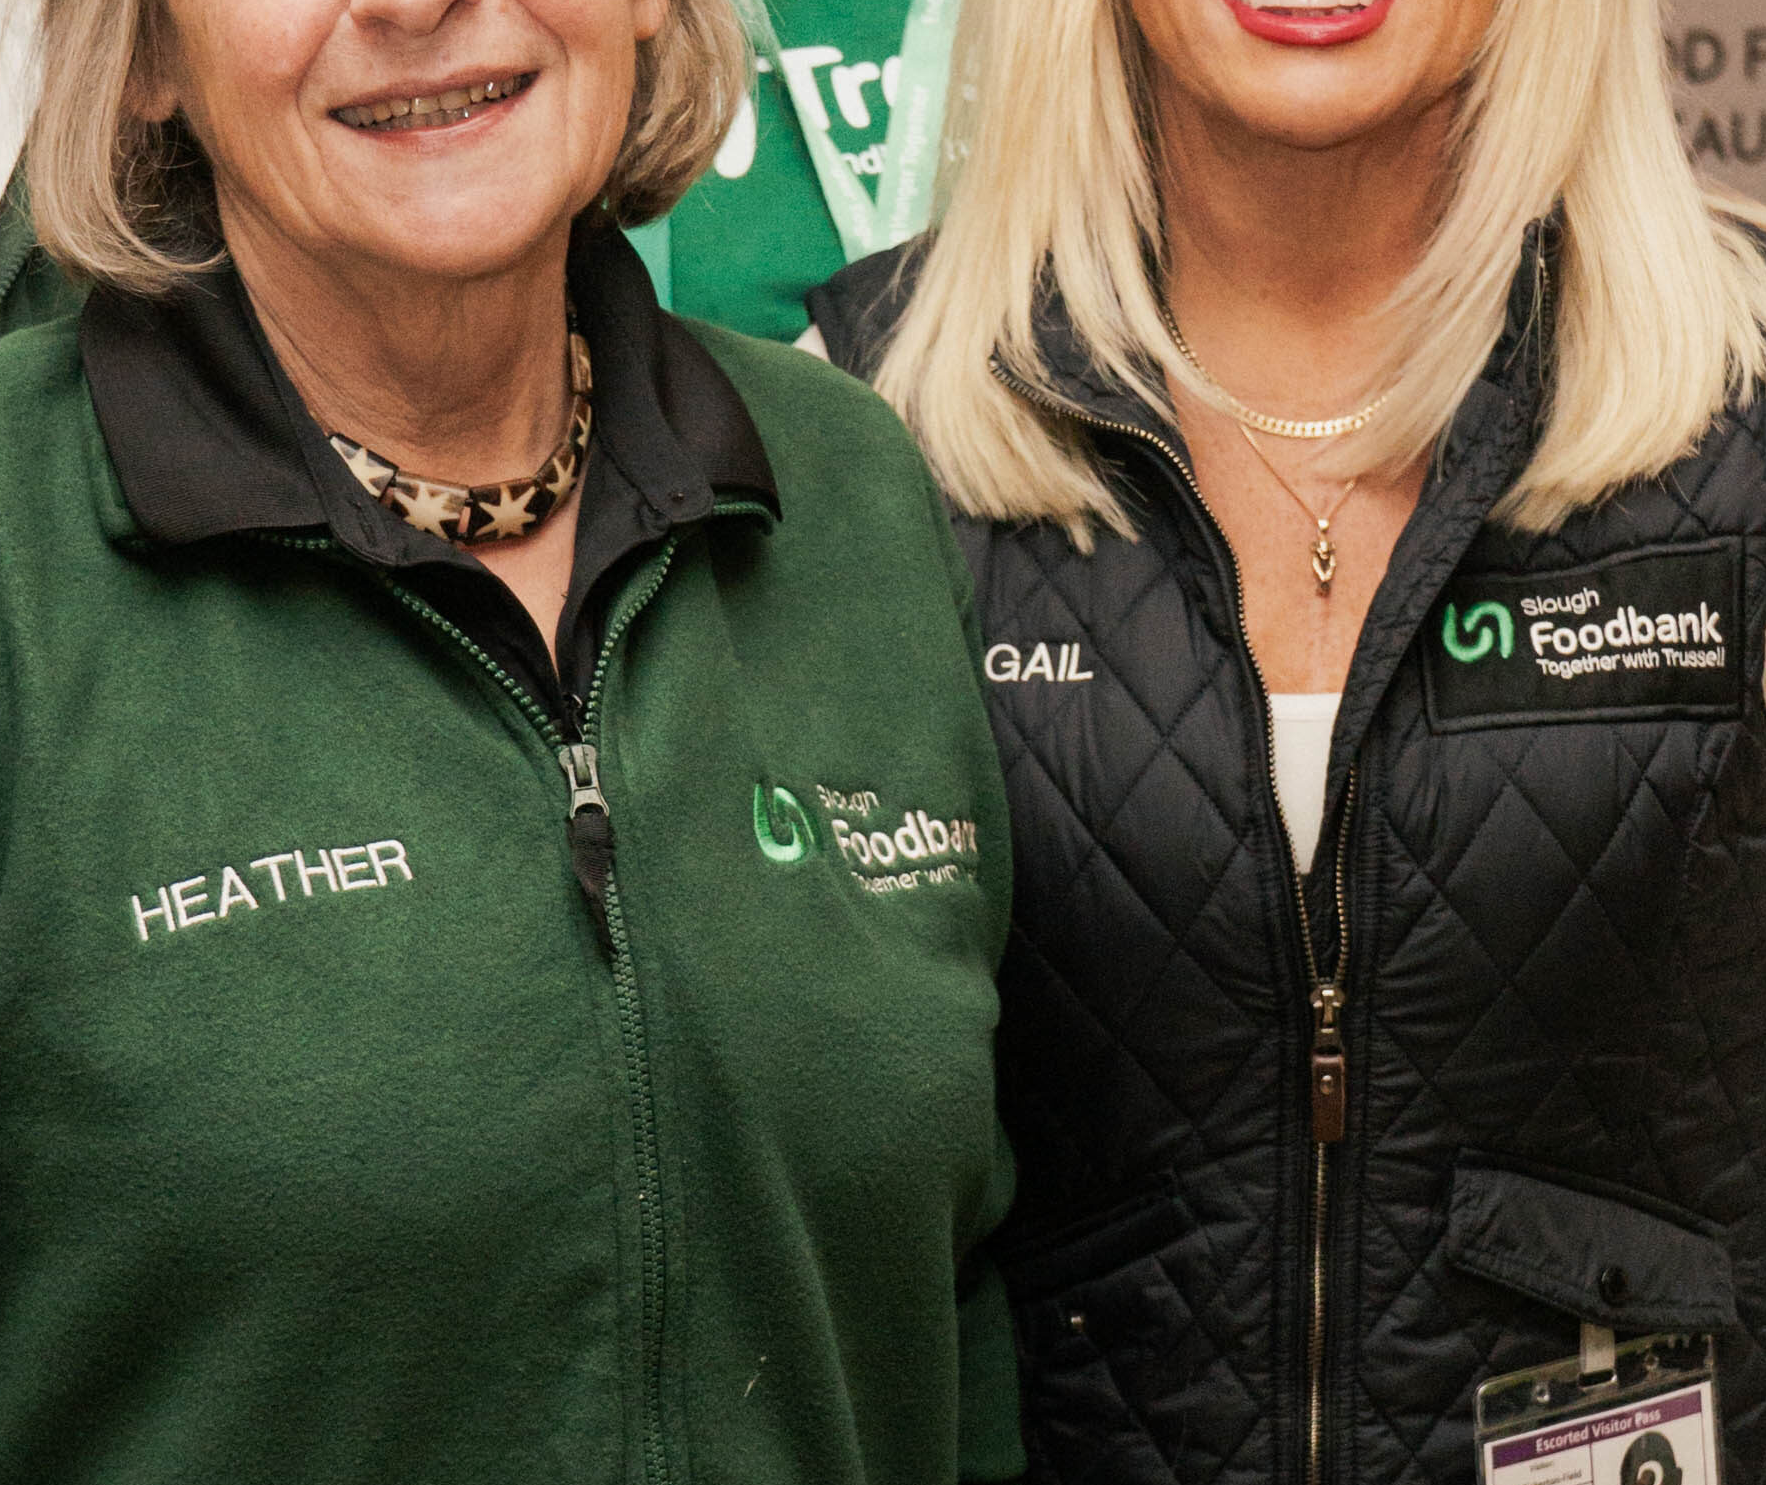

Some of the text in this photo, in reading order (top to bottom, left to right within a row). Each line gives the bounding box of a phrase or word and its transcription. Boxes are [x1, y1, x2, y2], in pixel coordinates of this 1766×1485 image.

[1520, 586, 1601, 616] Slough
[1529, 601, 1723, 657] Foodbank
[984, 641, 1095, 683] GAIL
[1535, 645, 1726, 680] Together with Trussell
[131, 839, 414, 942] HEATHER
[1535, 1408, 1662, 1453] Escorted Visitor Pass
